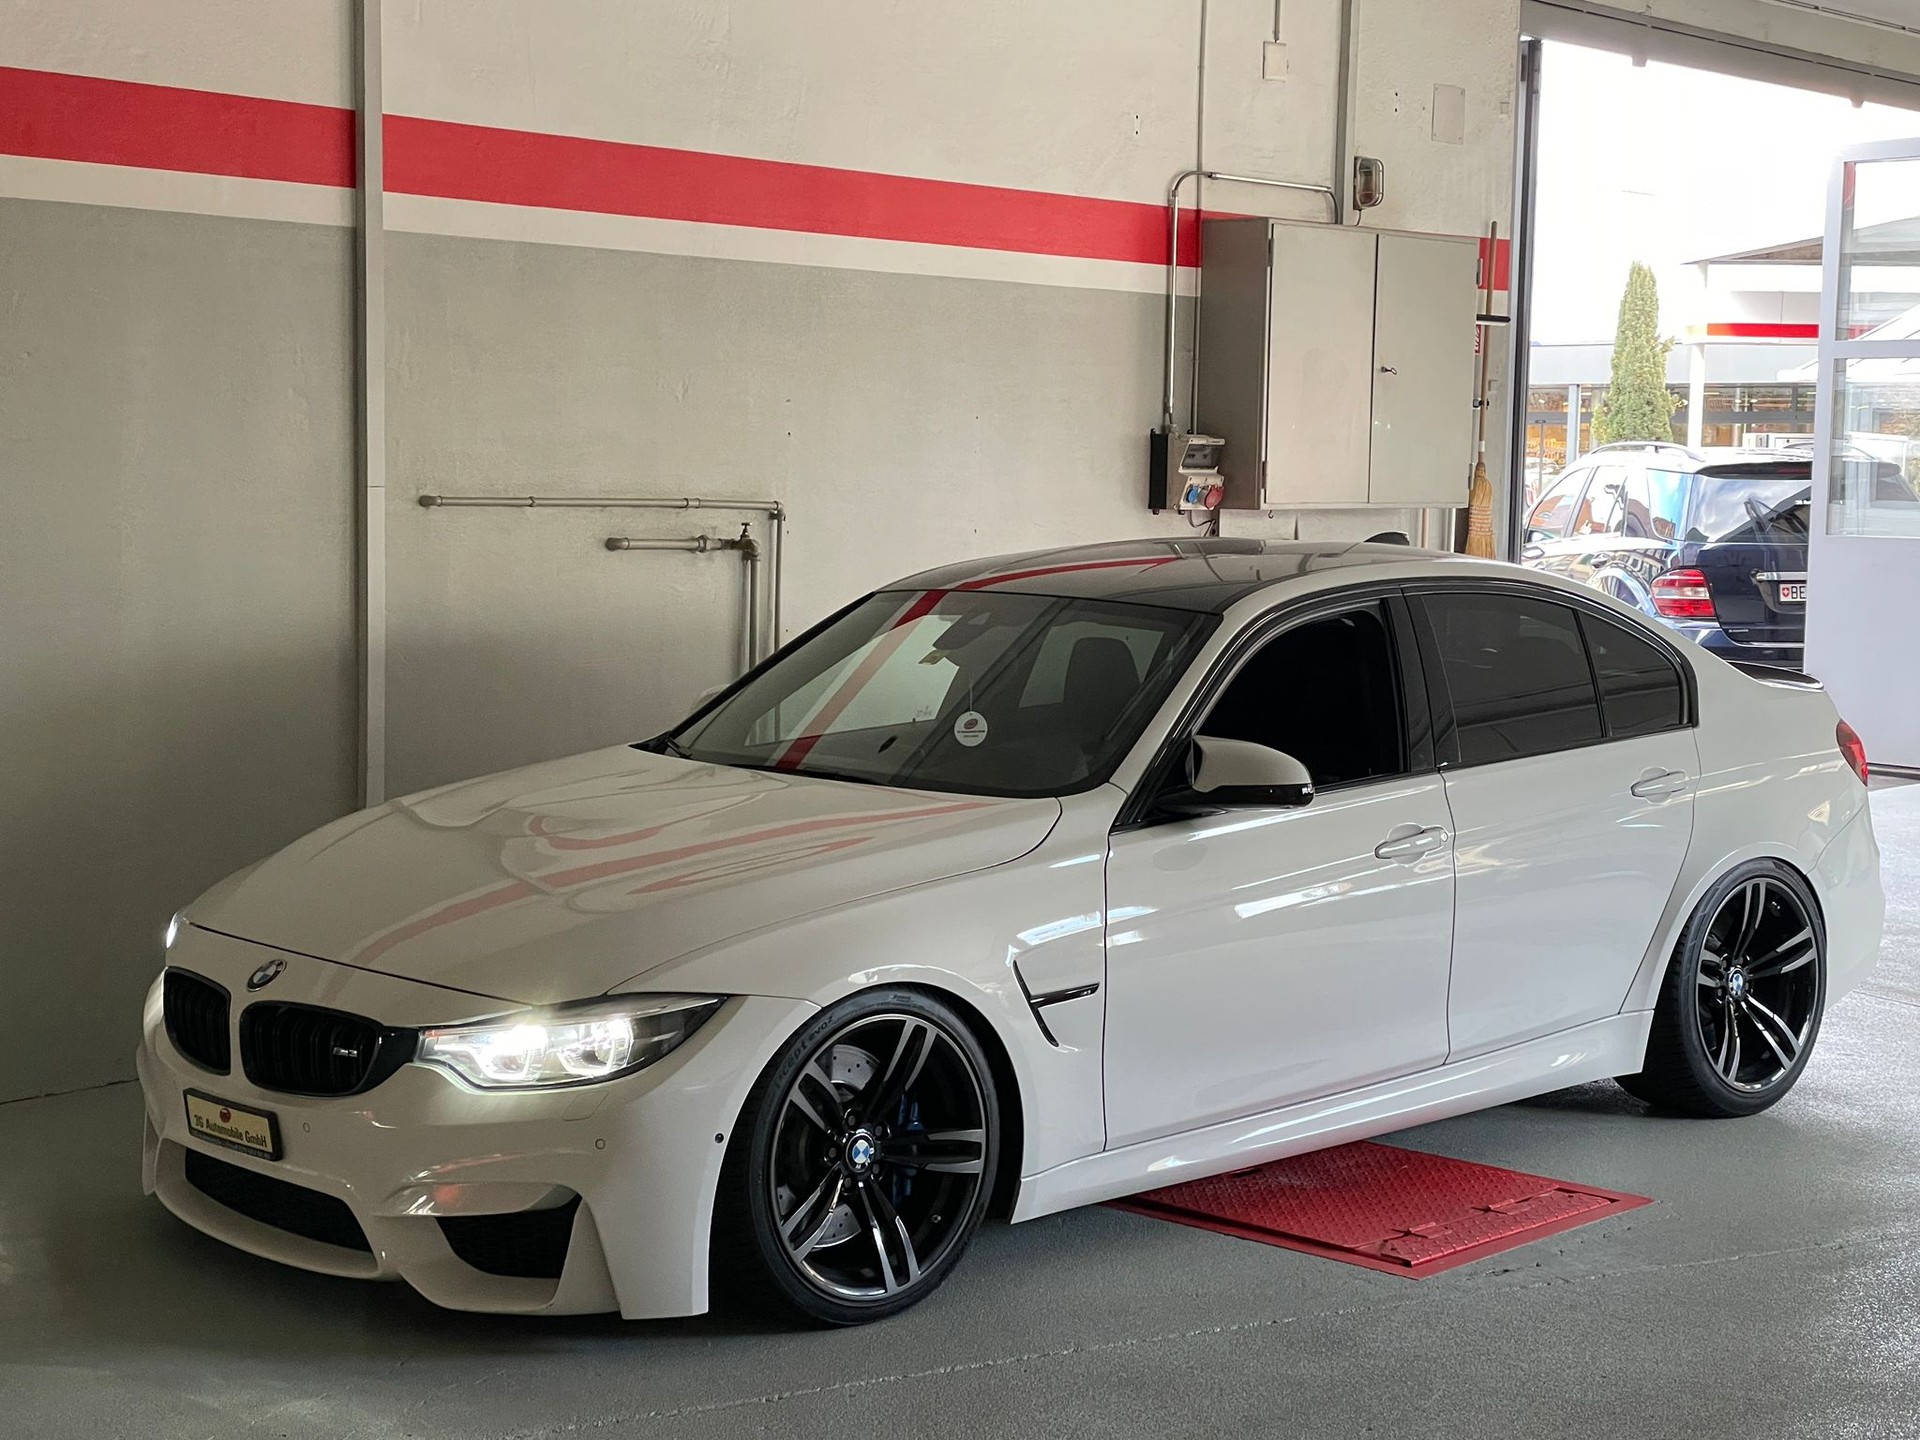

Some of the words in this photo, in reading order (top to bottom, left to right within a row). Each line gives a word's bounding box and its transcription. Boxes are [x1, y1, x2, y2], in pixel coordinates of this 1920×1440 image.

[1790, 585, 1807, 600] BE
[205, 1118, 244, 1141] Automobile
[244, 1130, 268, 1148] GmbH
